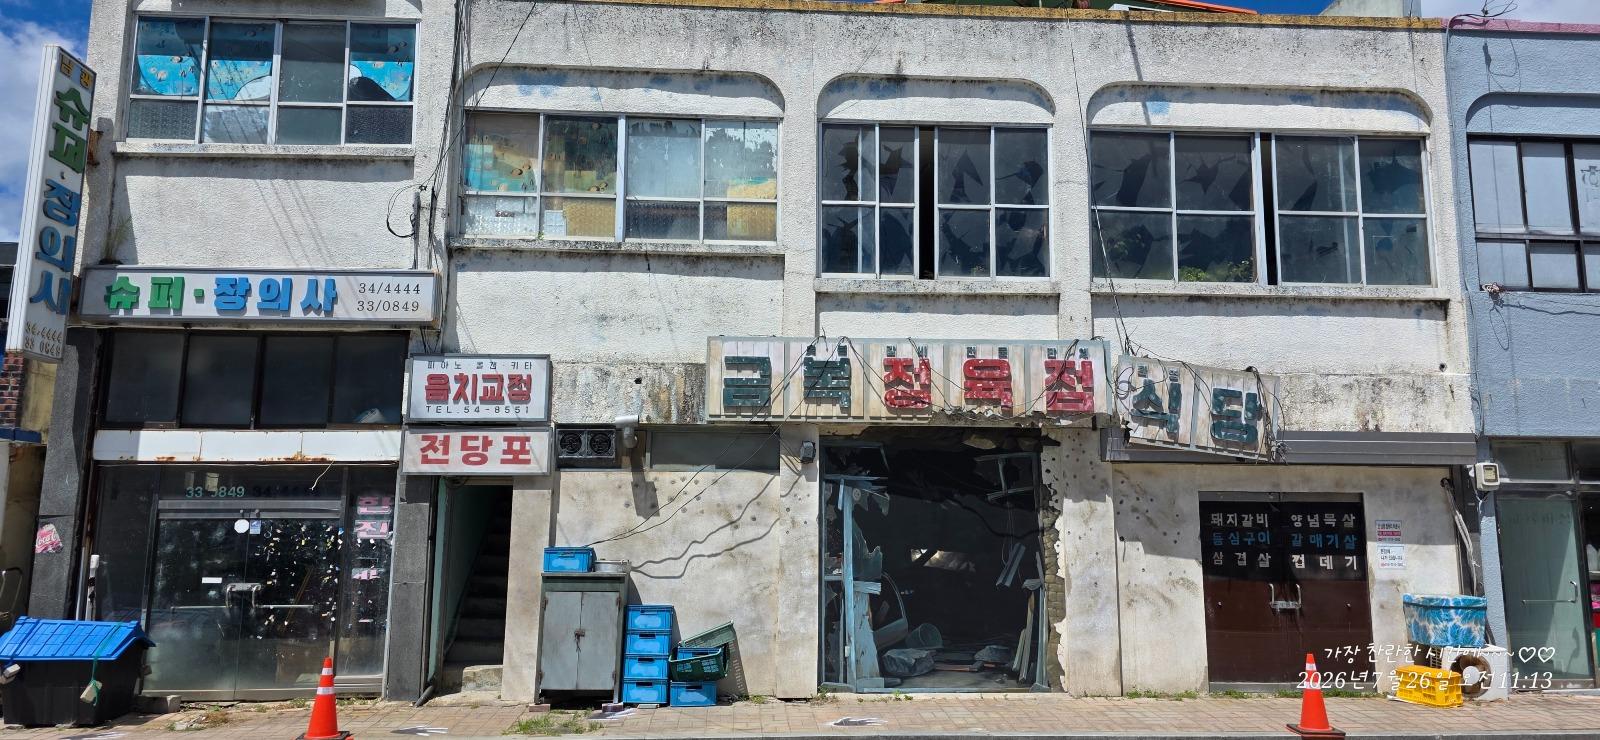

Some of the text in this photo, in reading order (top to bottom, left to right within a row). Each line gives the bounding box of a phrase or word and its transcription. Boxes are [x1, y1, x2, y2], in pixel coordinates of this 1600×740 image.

[358, 282, 421, 295] 34/4444
[357, 300, 420, 312] 33/0849
[425, 373, 532, 402] 음치교정
[1131, 379, 1261, 442] 식당
[420, 435, 531, 466] 전당포
[1210, 512, 1268, 527] 돼지갈비
[1291, 533, 1357, 549] 갈매기살
[1213, 551, 1271, 567] 삼겹살
[1292, 554, 1357, 570] 껍데기
